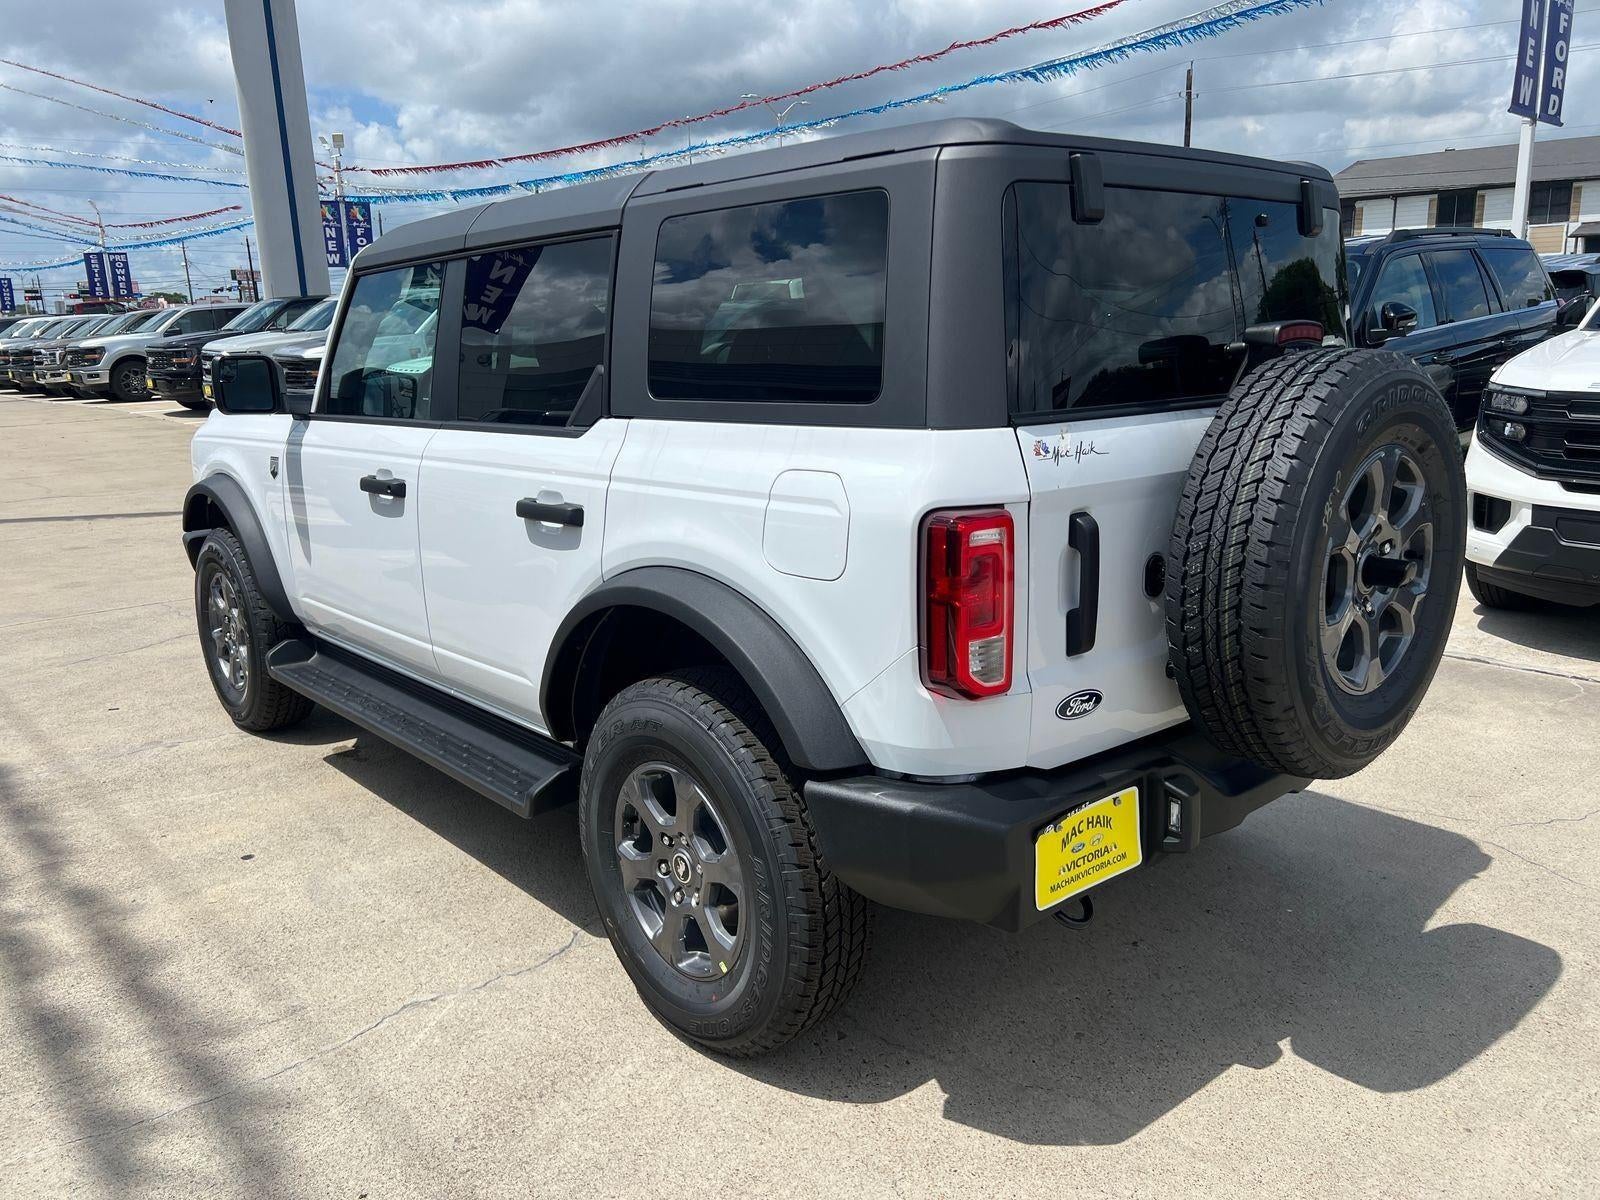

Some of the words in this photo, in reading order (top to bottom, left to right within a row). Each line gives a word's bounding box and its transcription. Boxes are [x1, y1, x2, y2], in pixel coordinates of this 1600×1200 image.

[1519, 0, 1539, 106] NEW
[1547, 12, 1568, 115] FORD
[325, 227, 340, 264] NEW
[356, 227, 368, 252] FO
[89, 254, 104, 296] CERTIFIED
[109, 254, 127, 262] PRE
[115, 262, 128, 295] OWNED
[1042, 444, 1073, 467] Mac
[1075, 440, 1105, 464] Haik
[1065, 694, 1097, 716] Ford
[1061, 820, 1084, 853] MAC
[1086, 815, 1113, 830] HAIK
[1049, 852, 1128, 894] MACHAIKVICTORIA.COM
[1066, 845, 1110, 873] VICTORIA
